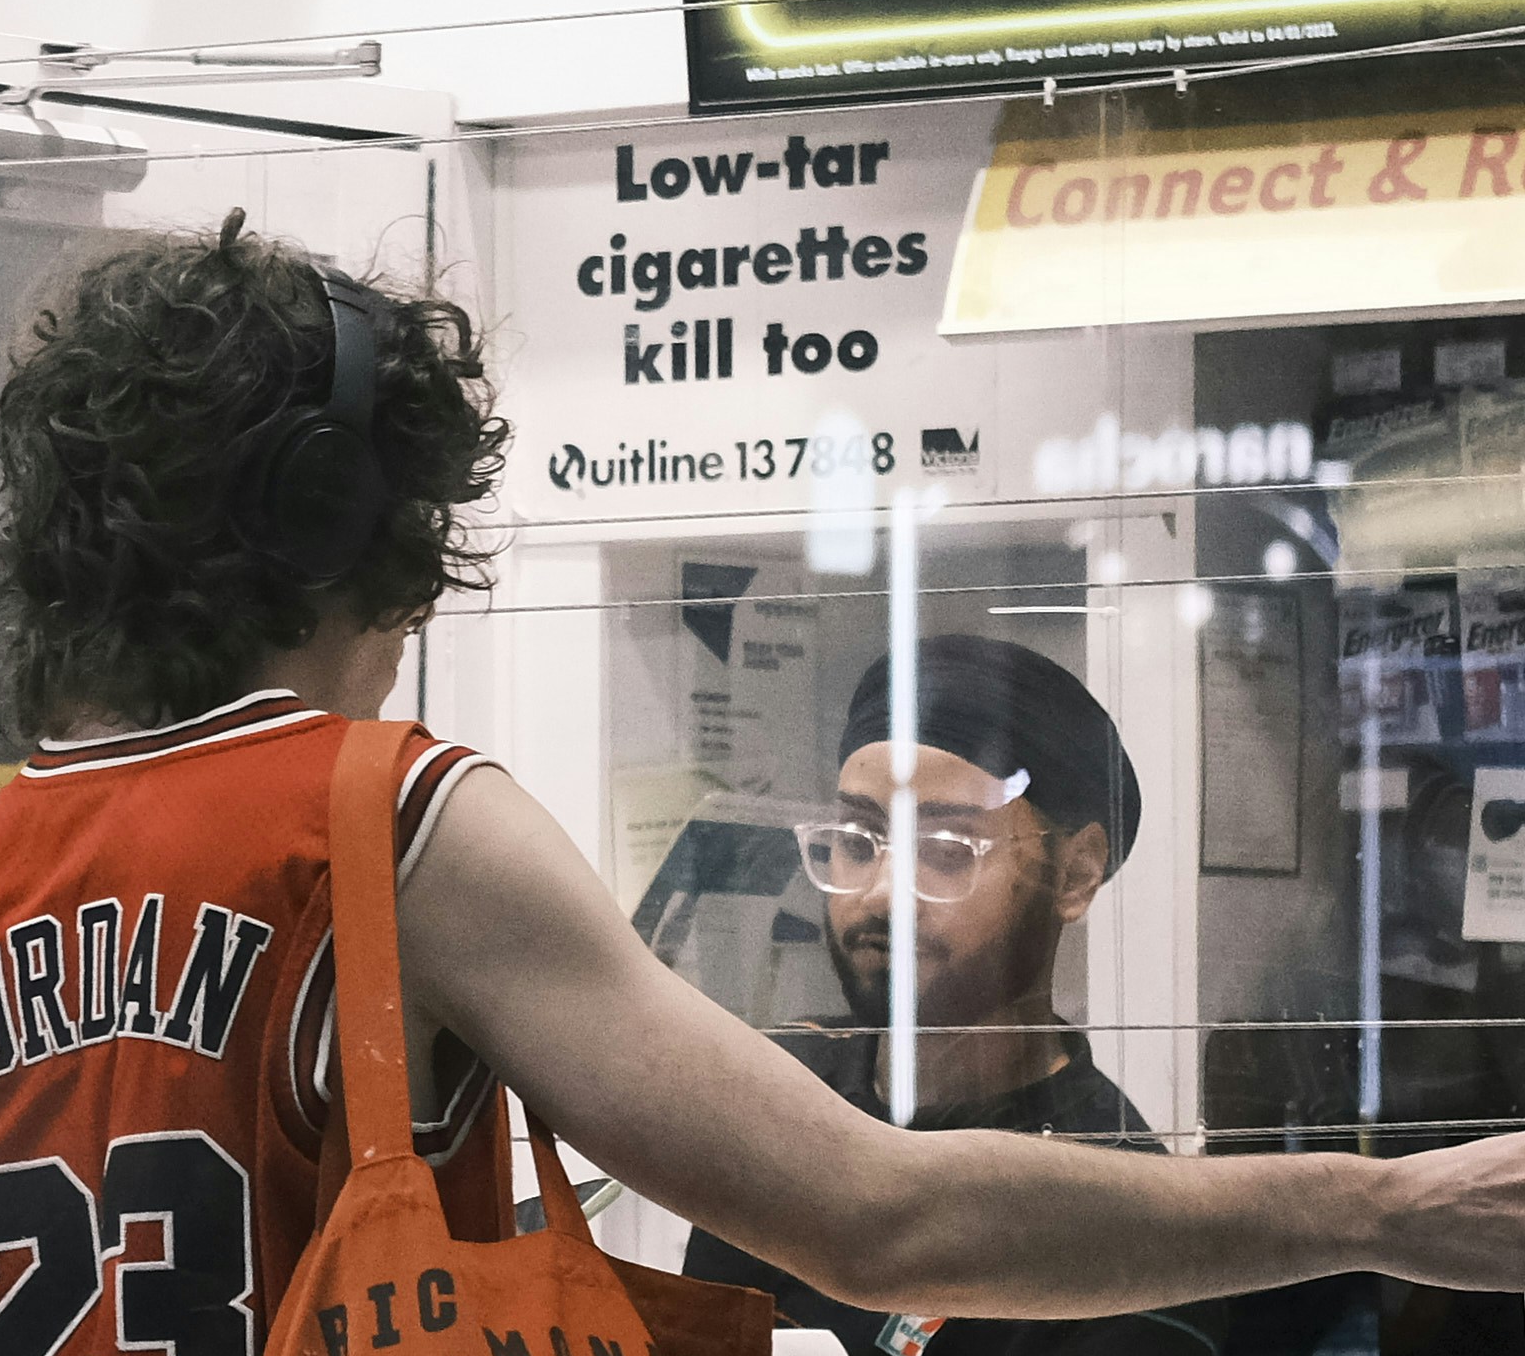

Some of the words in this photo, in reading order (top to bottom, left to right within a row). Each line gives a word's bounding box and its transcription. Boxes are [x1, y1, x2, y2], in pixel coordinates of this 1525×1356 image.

[616, 135, 890, 203] Low-tar
[1004, 143, 1345, 231] Connect
[1368, 130, 1427, 204] &
[577, 225, 929, 312] cigarettes
[624, 318, 734, 385] kill
[763, 322, 879, 377] too
[549, 439, 725, 490] Quitline
